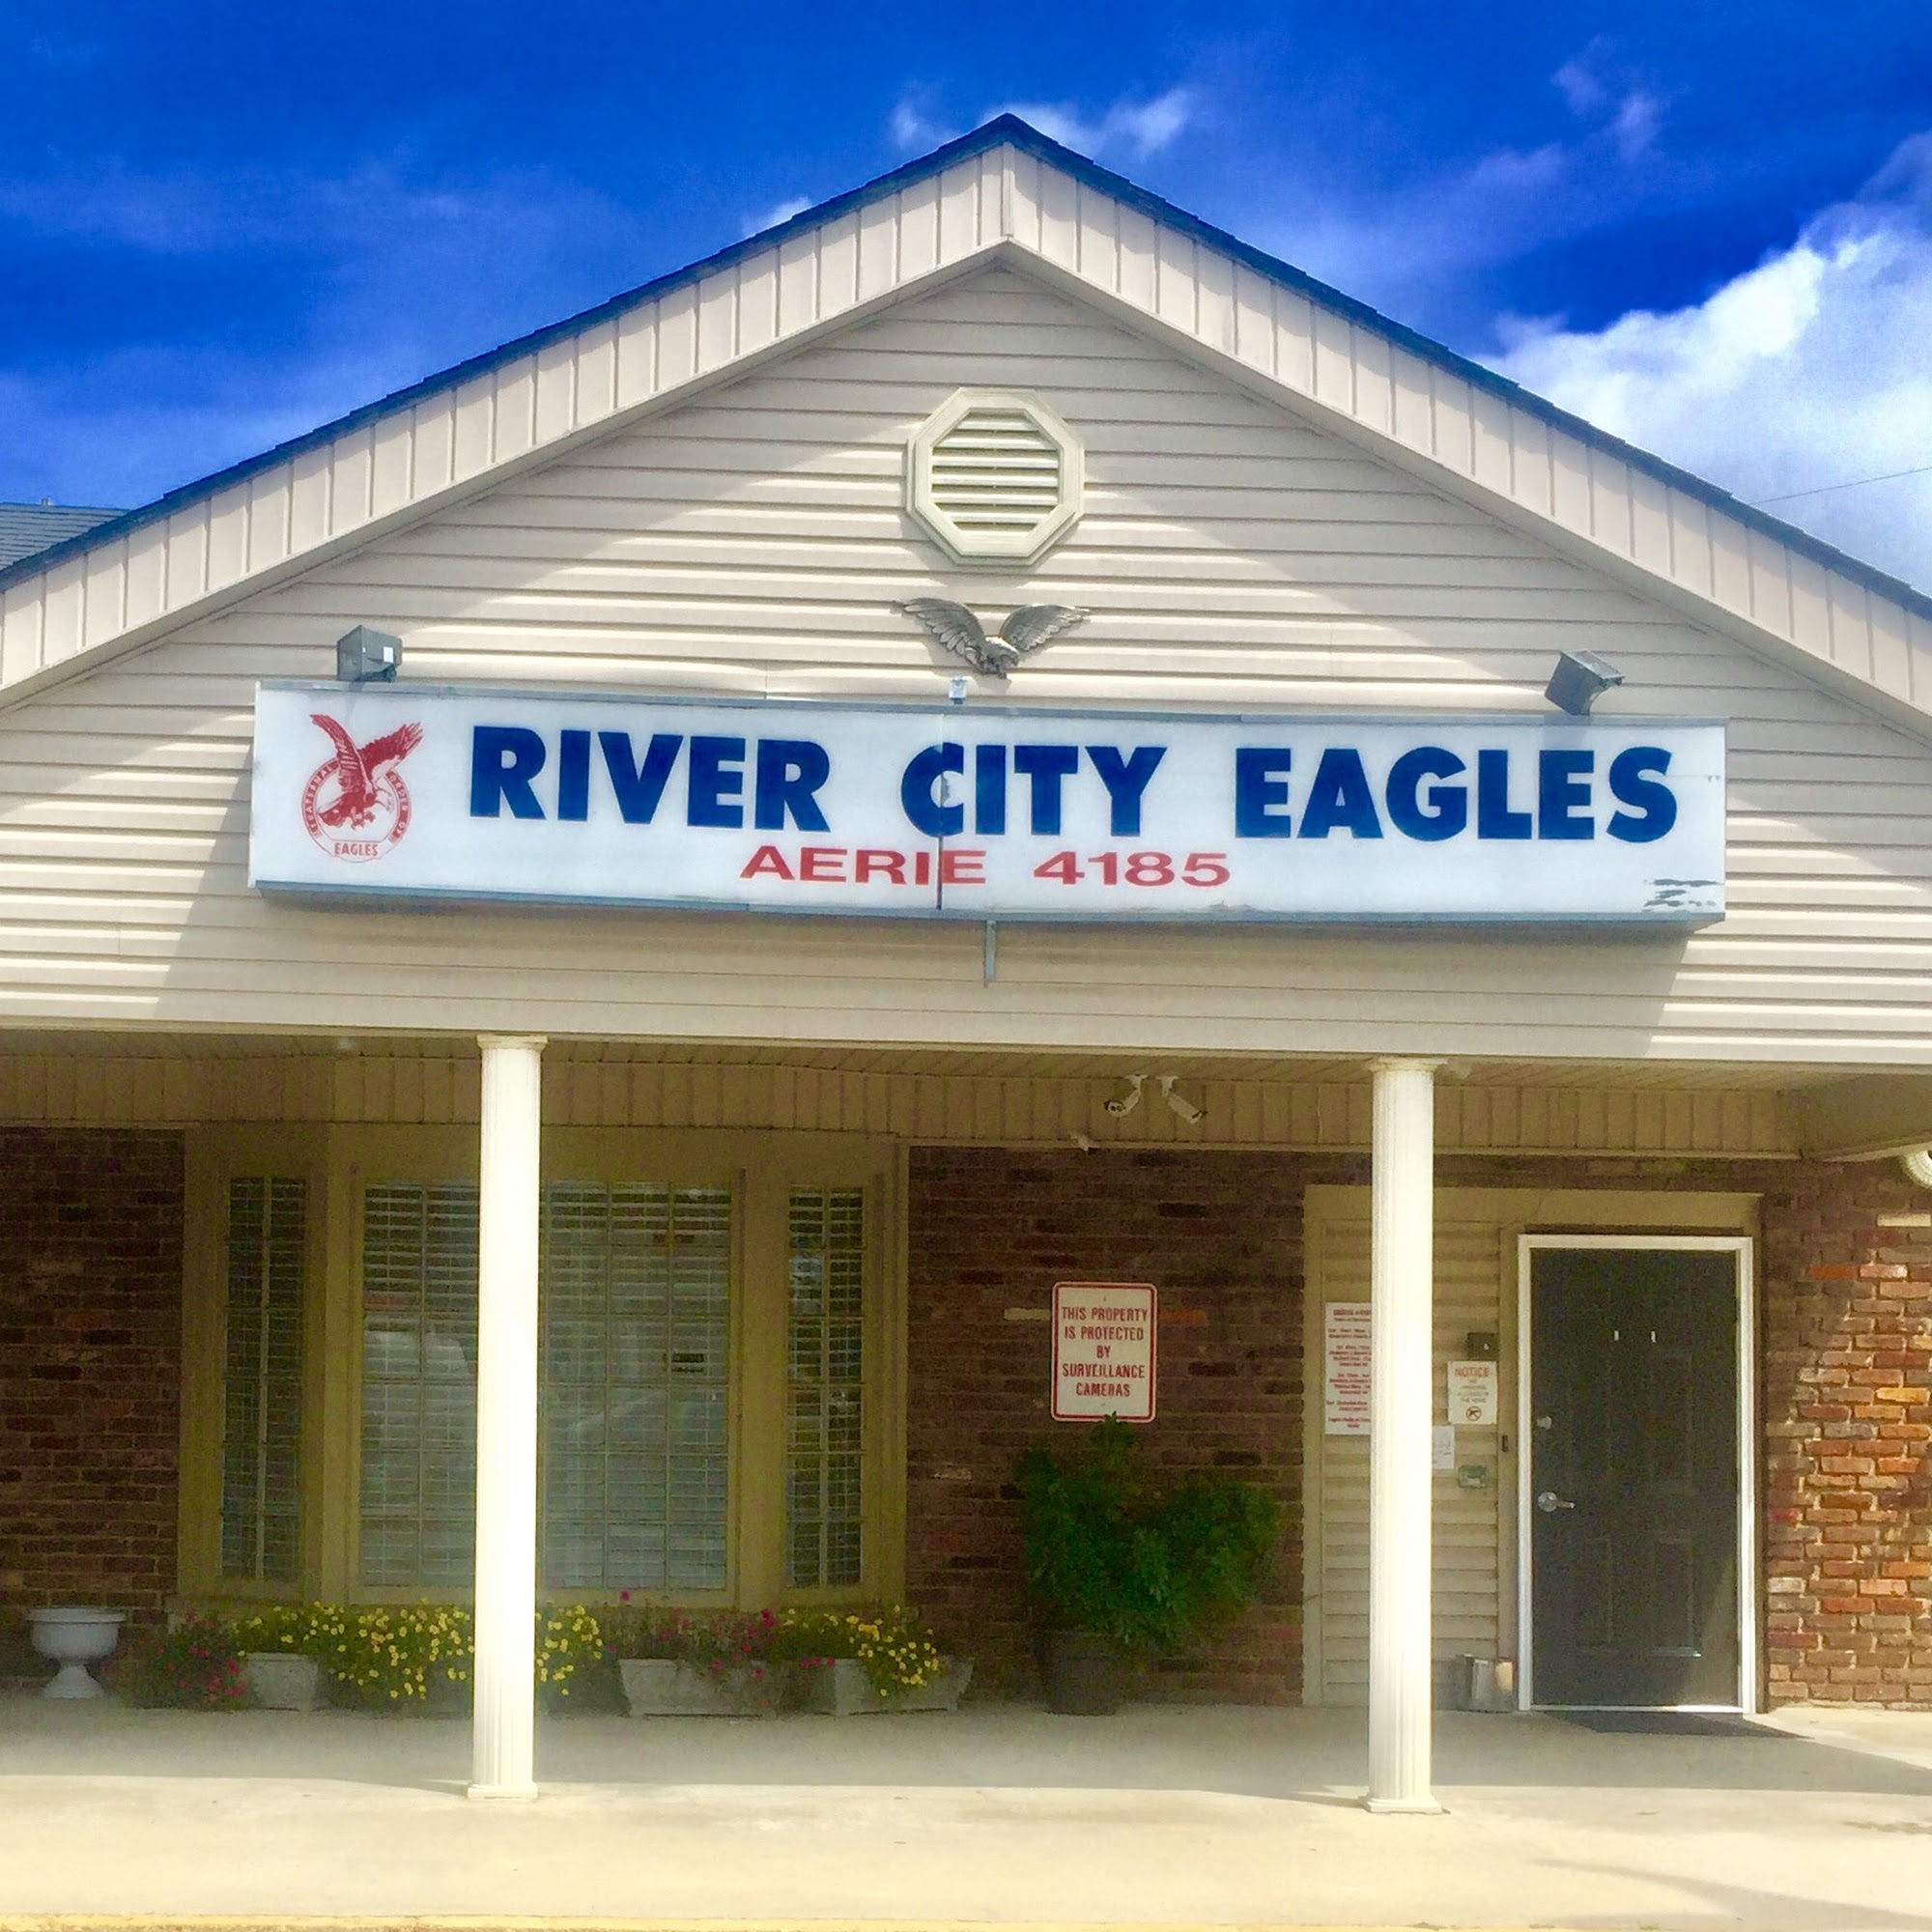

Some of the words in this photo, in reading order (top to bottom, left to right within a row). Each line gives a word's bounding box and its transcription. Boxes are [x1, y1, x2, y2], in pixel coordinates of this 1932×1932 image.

[469, 725, 831, 833] RIVER
[901, 742, 1167, 838] CITY
[1235, 746, 1677, 843] EAGLES
[334, 843, 378, 856] EAGLES
[740, 845, 986, 885] AERIE
[1034, 851, 1231, 888] 4185
[1062, 1307, 1087, 1321] THIS
[1092, 1308, 1148, 1321] PROPERTY
[1065, 1326, 1075, 1339] IS
[1081, 1326, 1144, 1341] PROTECTED
[1096, 1346, 1111, 1358] BY
[1062, 1363, 1145, 1378] SURVEILLANCE
[1455, 1367, 1489, 1378] NOTICE
[1076, 1382, 1130, 1397] CAMERAS
